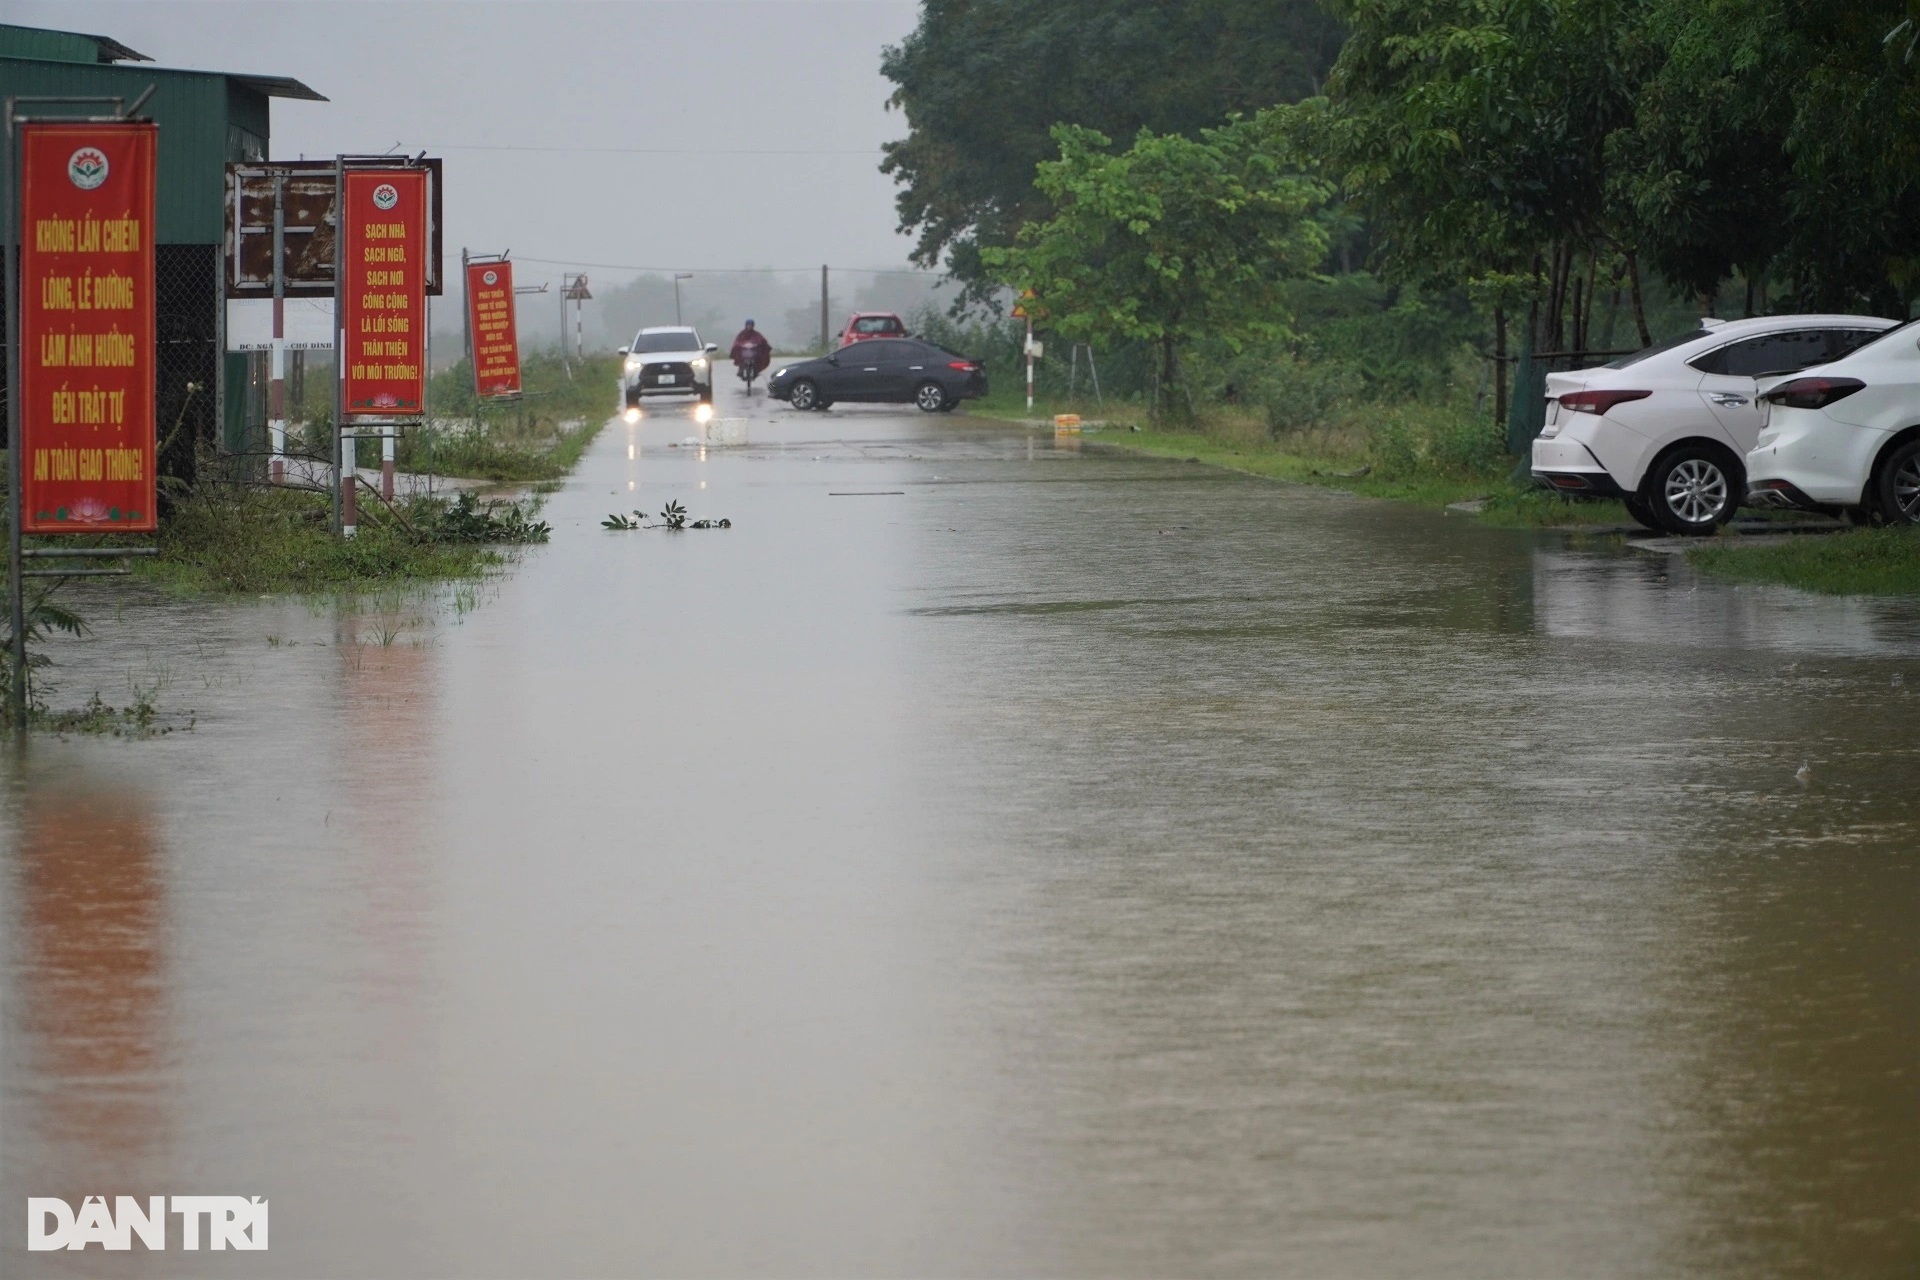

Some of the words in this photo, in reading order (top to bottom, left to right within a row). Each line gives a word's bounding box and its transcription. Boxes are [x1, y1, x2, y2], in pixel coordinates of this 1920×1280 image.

[36, 213, 75, 251] KHÔNG
[77, 208, 101, 251] LẤN
[103, 209, 139, 251] CHIẾM
[365, 223, 387, 241] SẠCH
[388, 221, 406, 238] NHÀ
[364, 247, 386, 265] SẠCH
[387, 245, 407, 263] NGÕ,
[366, 271, 388, 288] SẠCH
[389, 270, 404, 285] NƠI
[42, 269, 76, 313] LÒNG,
[94, 269, 134, 309] ĐƯỜNG
[362, 291, 385, 309] CÔNG
[386, 291, 408, 312] CỘNG
[361, 315, 371, 333] LÀ
[372, 312, 386, 333] LỐI
[387, 312, 409, 333] SỐNG
[41, 327, 66, 367] LÀM
[68, 323, 93, 367] ẢNH
[95, 323, 135, 367] HƯỞNG
[362, 338, 384, 356] THÂN
[385, 338, 408, 360] THIỆN
[352, 360, 365, 380] VỚI
[366, 361, 383, 380] MÔI
[384, 361, 418, 380] TRƯỜNG!
[52, 380, 76, 424] ĐẾN
[78, 384, 107, 431] TRẬT
[108, 388, 125, 431] TỰ
[34, 449, 49, 481] AN
[50, 441, 77, 481] TOÀN
[79, 448, 103, 481] GIAO
[105, 442, 143, 481] THÔNG!
